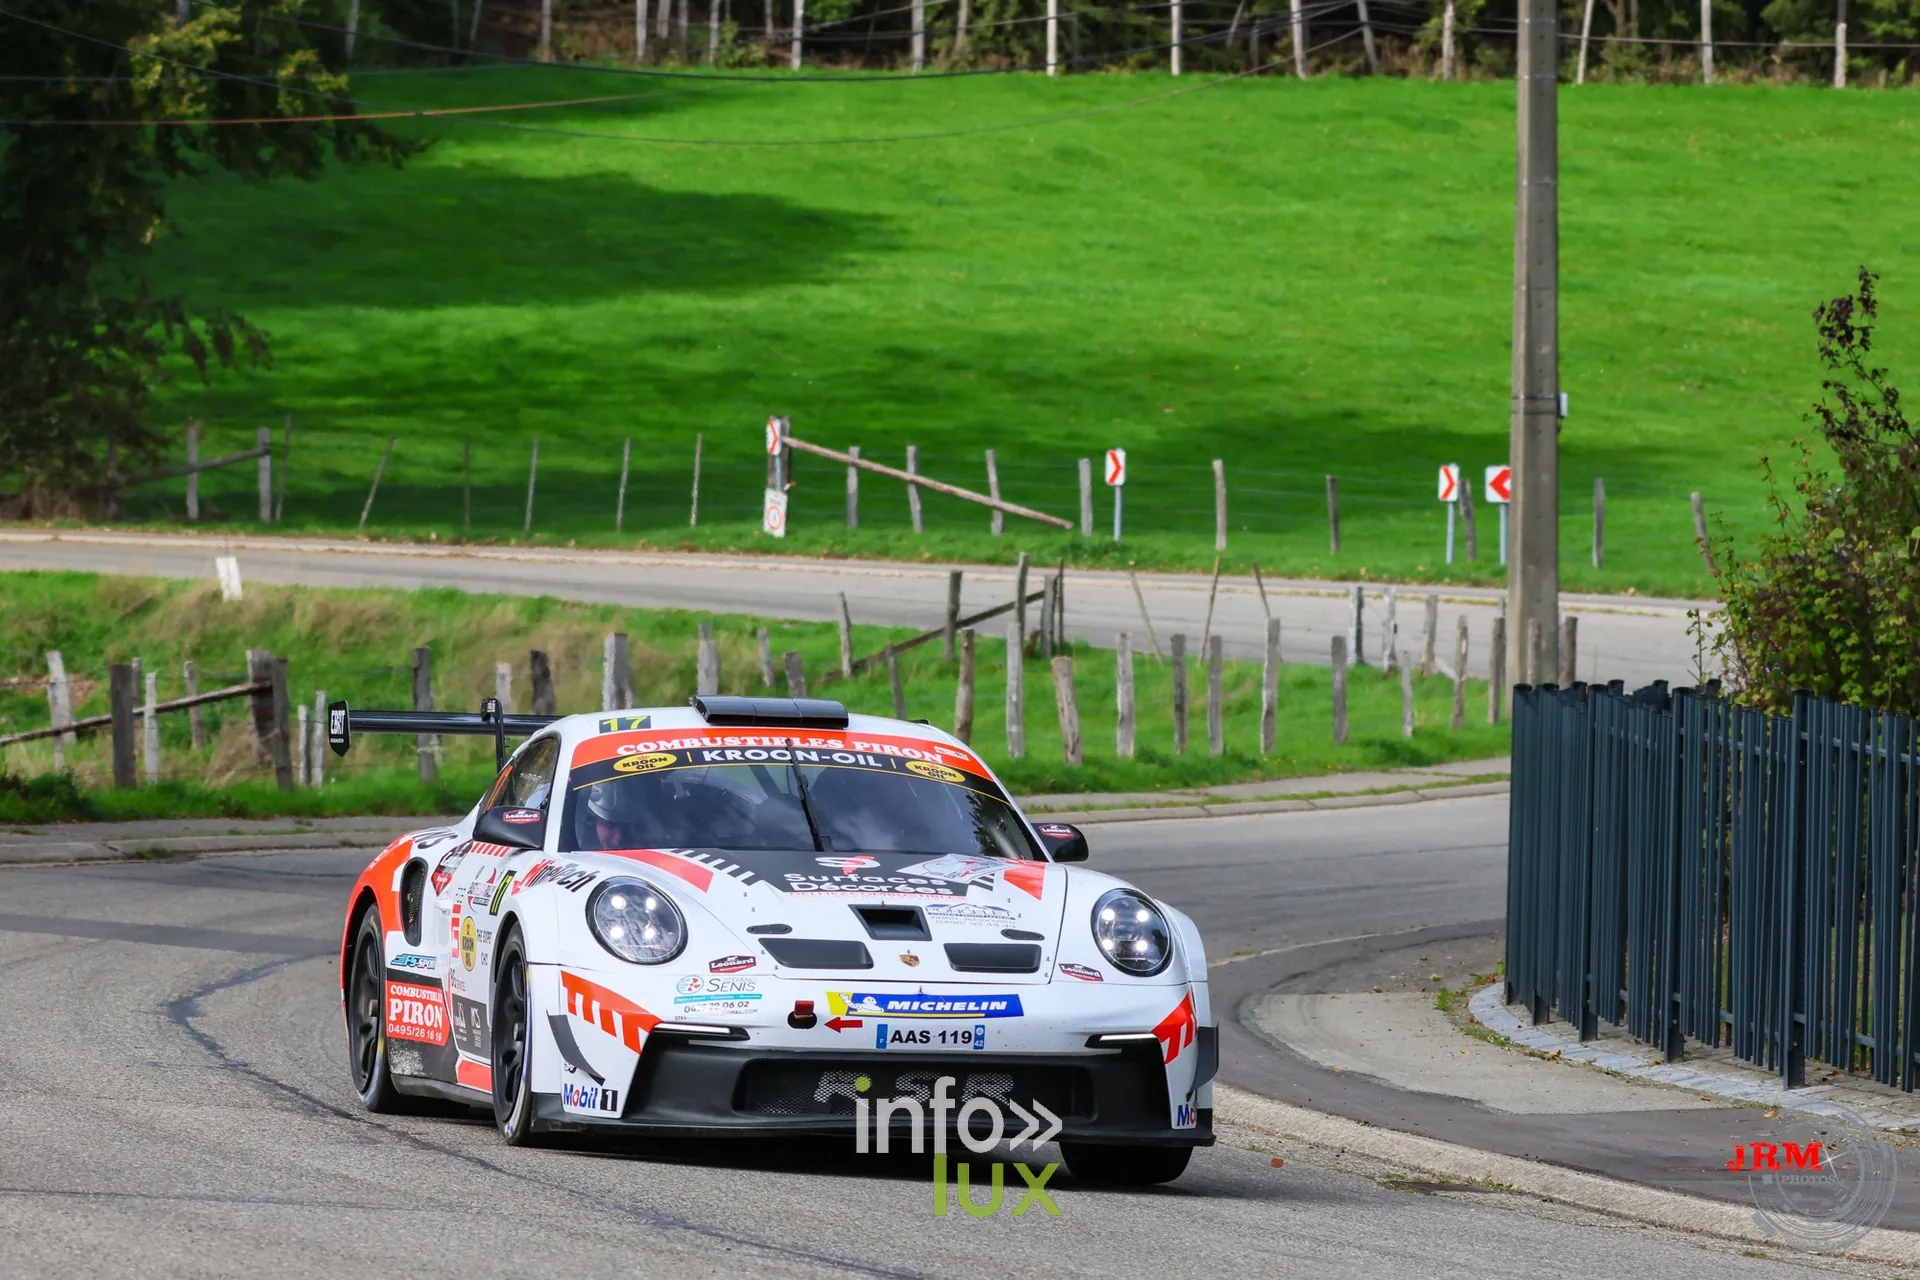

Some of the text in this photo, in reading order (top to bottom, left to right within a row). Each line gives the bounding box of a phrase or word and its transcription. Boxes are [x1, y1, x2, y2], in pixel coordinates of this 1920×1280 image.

[602, 716, 649, 731] 17
[616, 736, 844, 756] COMBUSTIBLES
[851, 740, 943, 764] PIRON
[622, 756, 668, 768] KROON
[703, 749, 882, 767] KROON-OIL
[913, 764, 957, 778] KROON
[927, 771, 946, 779] OIL
[783, 873, 948, 887] Surfaces
[789, 881, 954, 896] Décorées
[710, 957, 755, 969] Leonard
[706, 978, 756, 992] SENIS
[722, 1001, 735, 1009] 06
[886, 1000, 1008, 1011] MICHELIN
[389, 998, 443, 1029] PIRON
[889, 1029, 931, 1044] AAS
[938, 1030, 972, 1044] 119
[974, 1040, 984, 1048] 42
[563, 1083, 599, 1110] Mobil
